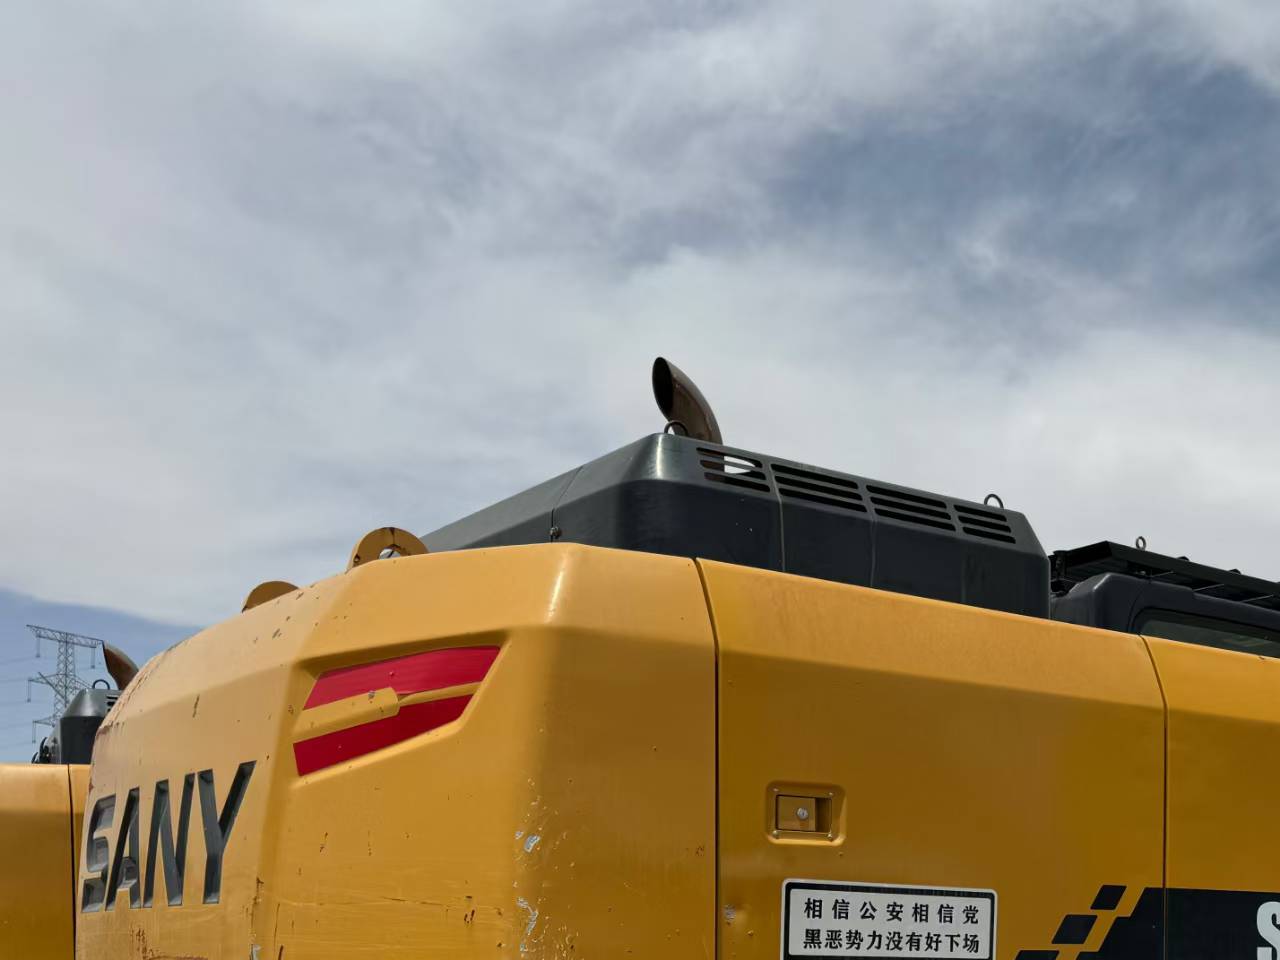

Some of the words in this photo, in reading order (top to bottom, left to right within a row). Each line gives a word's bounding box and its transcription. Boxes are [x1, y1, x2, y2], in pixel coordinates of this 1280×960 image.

[82, 760, 257, 913] SANY
[803, 897, 979, 925] 相信公安相信党
[803, 928, 980, 953] 黑恶势力没有好下场
